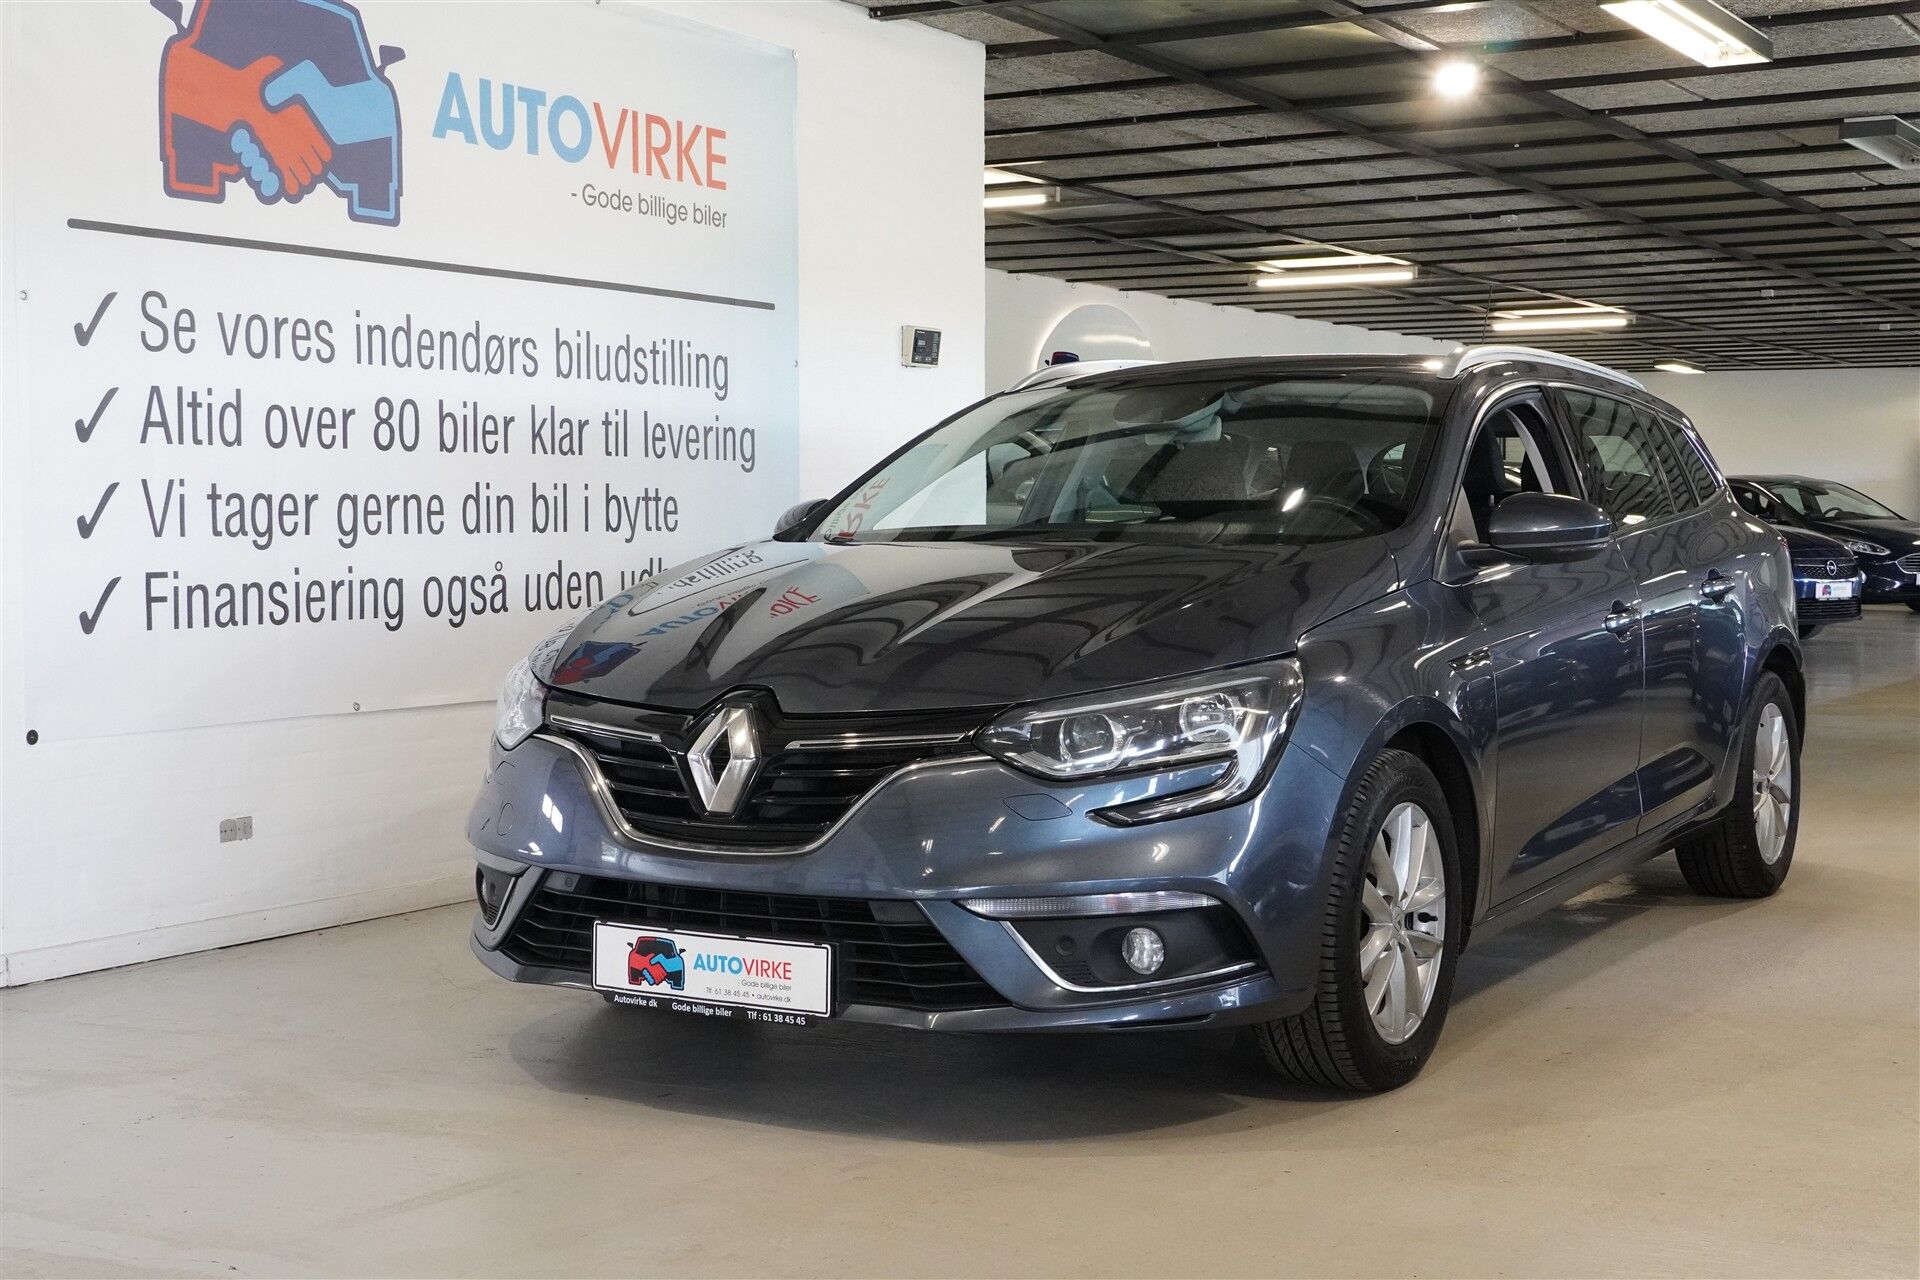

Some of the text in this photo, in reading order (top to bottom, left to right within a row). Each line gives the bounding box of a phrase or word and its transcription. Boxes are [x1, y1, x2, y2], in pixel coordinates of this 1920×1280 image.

[432, 71, 728, 191] AUTOVIRKE
[582, 183, 633, 213] Gode
[638, 192, 688, 225] billige
[693, 203, 727, 228] biler
[140, 291, 729, 402] Se vores indendørs biludstilling
[140, 386, 757, 474] Altid over 80 biler klar til levering
[141, 478, 680, 551] Vi tager gerne din bil i bytte
[145, 565, 404, 633] Finansiering
[423, 560, 509, 629] også
[525, 560, 604, 614] uden
[693, 952, 792, 981] AUTOVIRKE
[741, 979, 759, 988] Gode
[614, 994, 647, 1007] Autovirke
[671, 1002, 733, 1017] Gode billige biler
[762, 1012, 773, 1022] 61
[774, 1014, 784, 1023] 38
[784, 1015, 795, 1025] 45
[795, 1016, 806, 1026] 45
